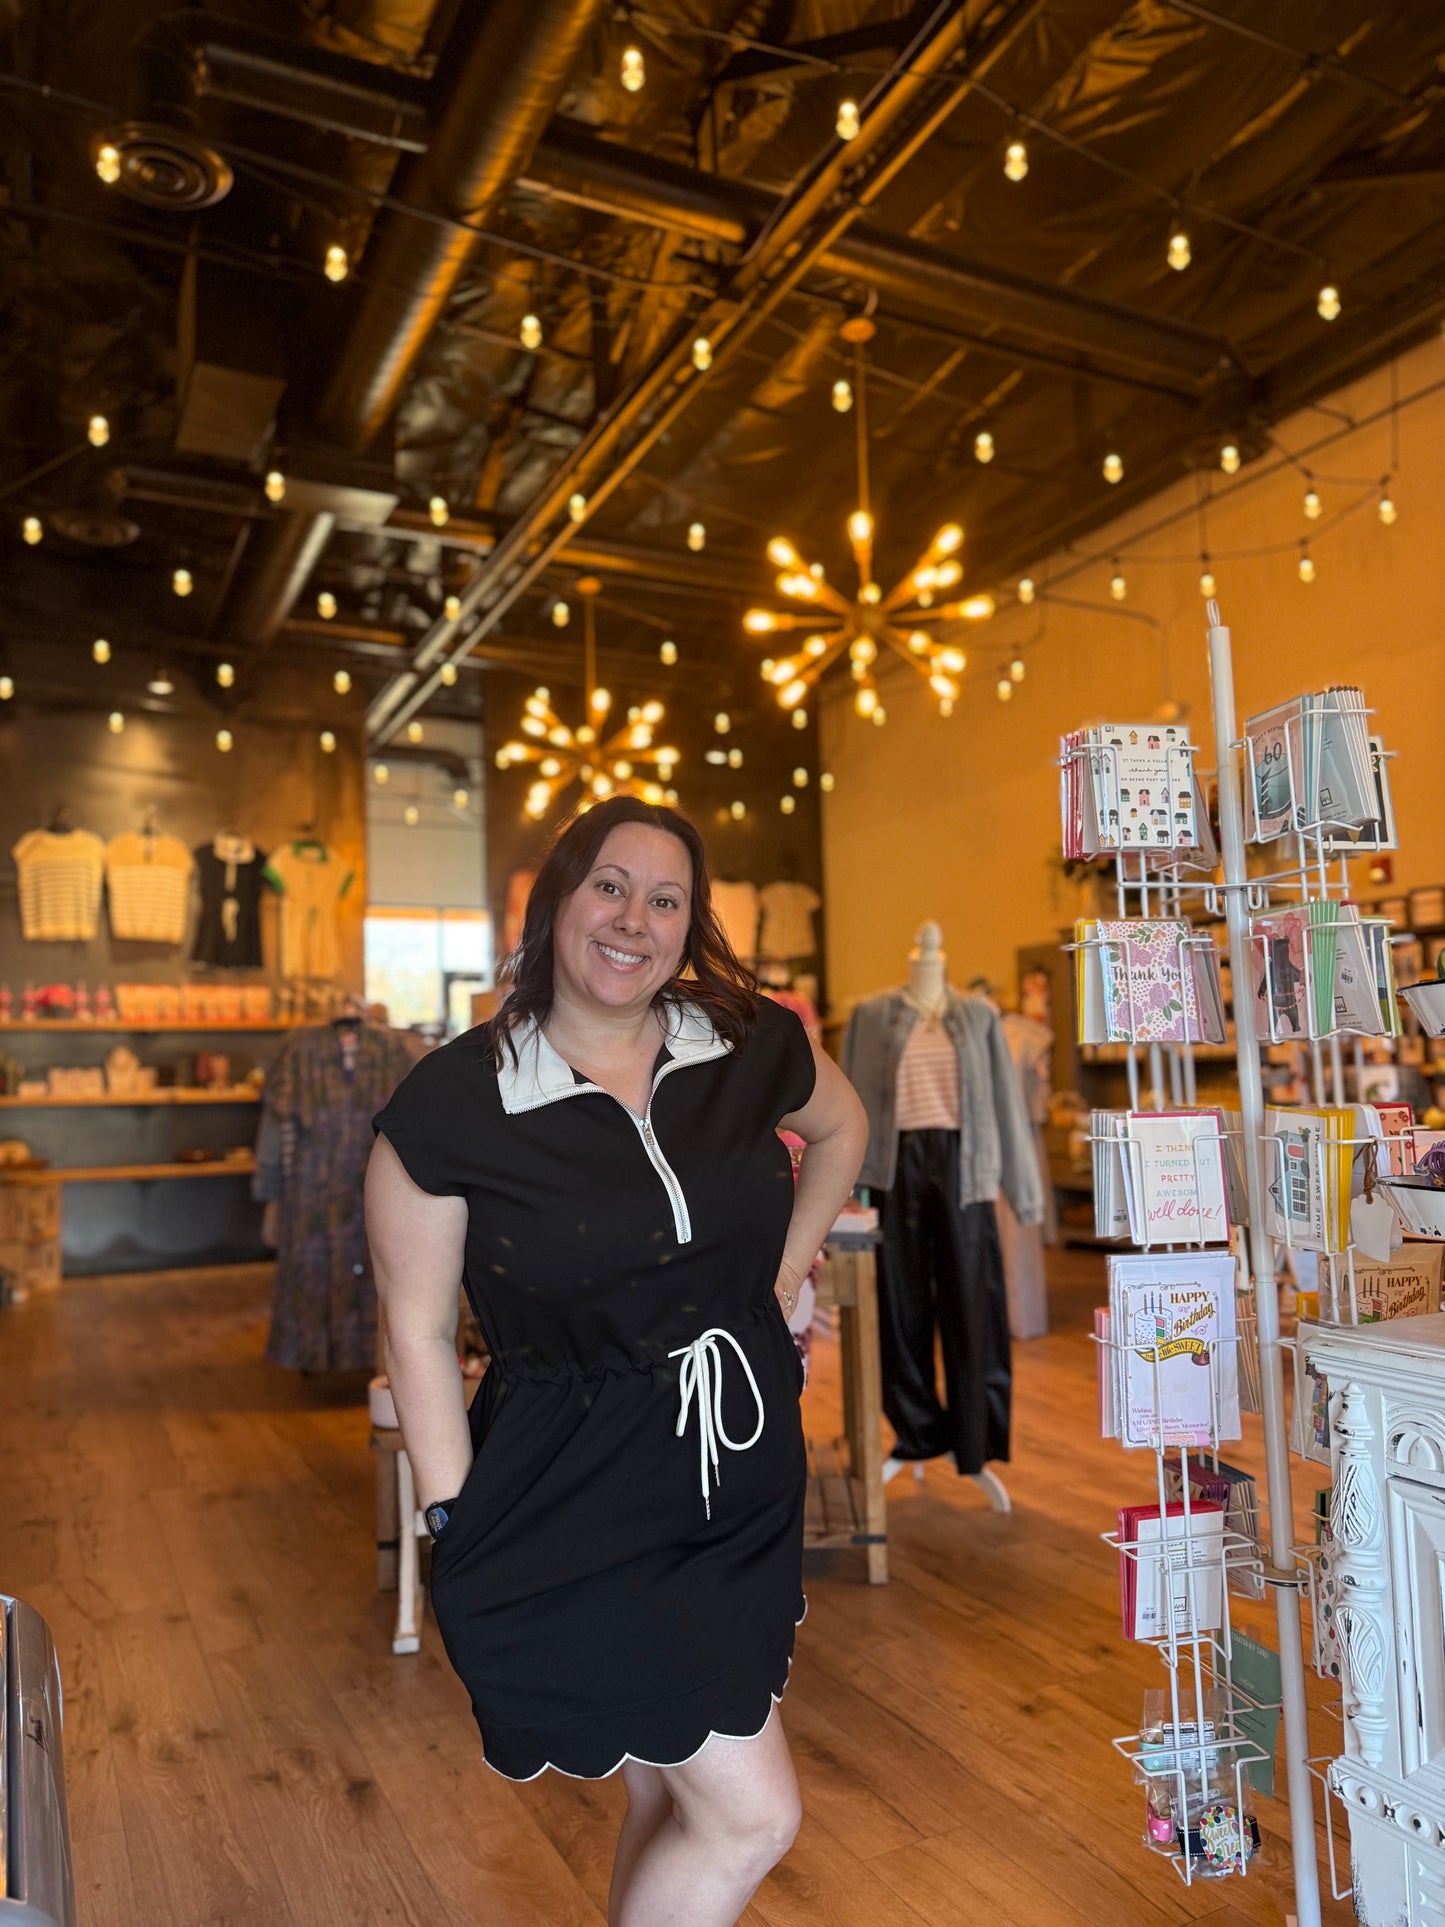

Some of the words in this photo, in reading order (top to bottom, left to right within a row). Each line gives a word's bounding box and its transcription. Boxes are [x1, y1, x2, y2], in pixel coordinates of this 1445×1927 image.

[1264, 742, 1282, 765] 60
[1111, 966, 1158, 981] Thank
[1155, 1145, 1162, 1153] I
[1144, 1160, 1151, 1168] I
[1154, 1159, 1190, 1168] TURNED
[1199, 1158, 1211, 1166] UT
[1161, 1174, 1195, 1183] PRETTY
[1156, 1189, 1198, 1197] AWESOM
[1148, 1199, 1176, 1222] well
[1387, 1275, 1423, 1288] HAPPY
[1170, 1290, 1210, 1304] HAPPY
[1388, 1286, 1427, 1320] Birthday
[1173, 1302, 1216, 1338] Birthday
